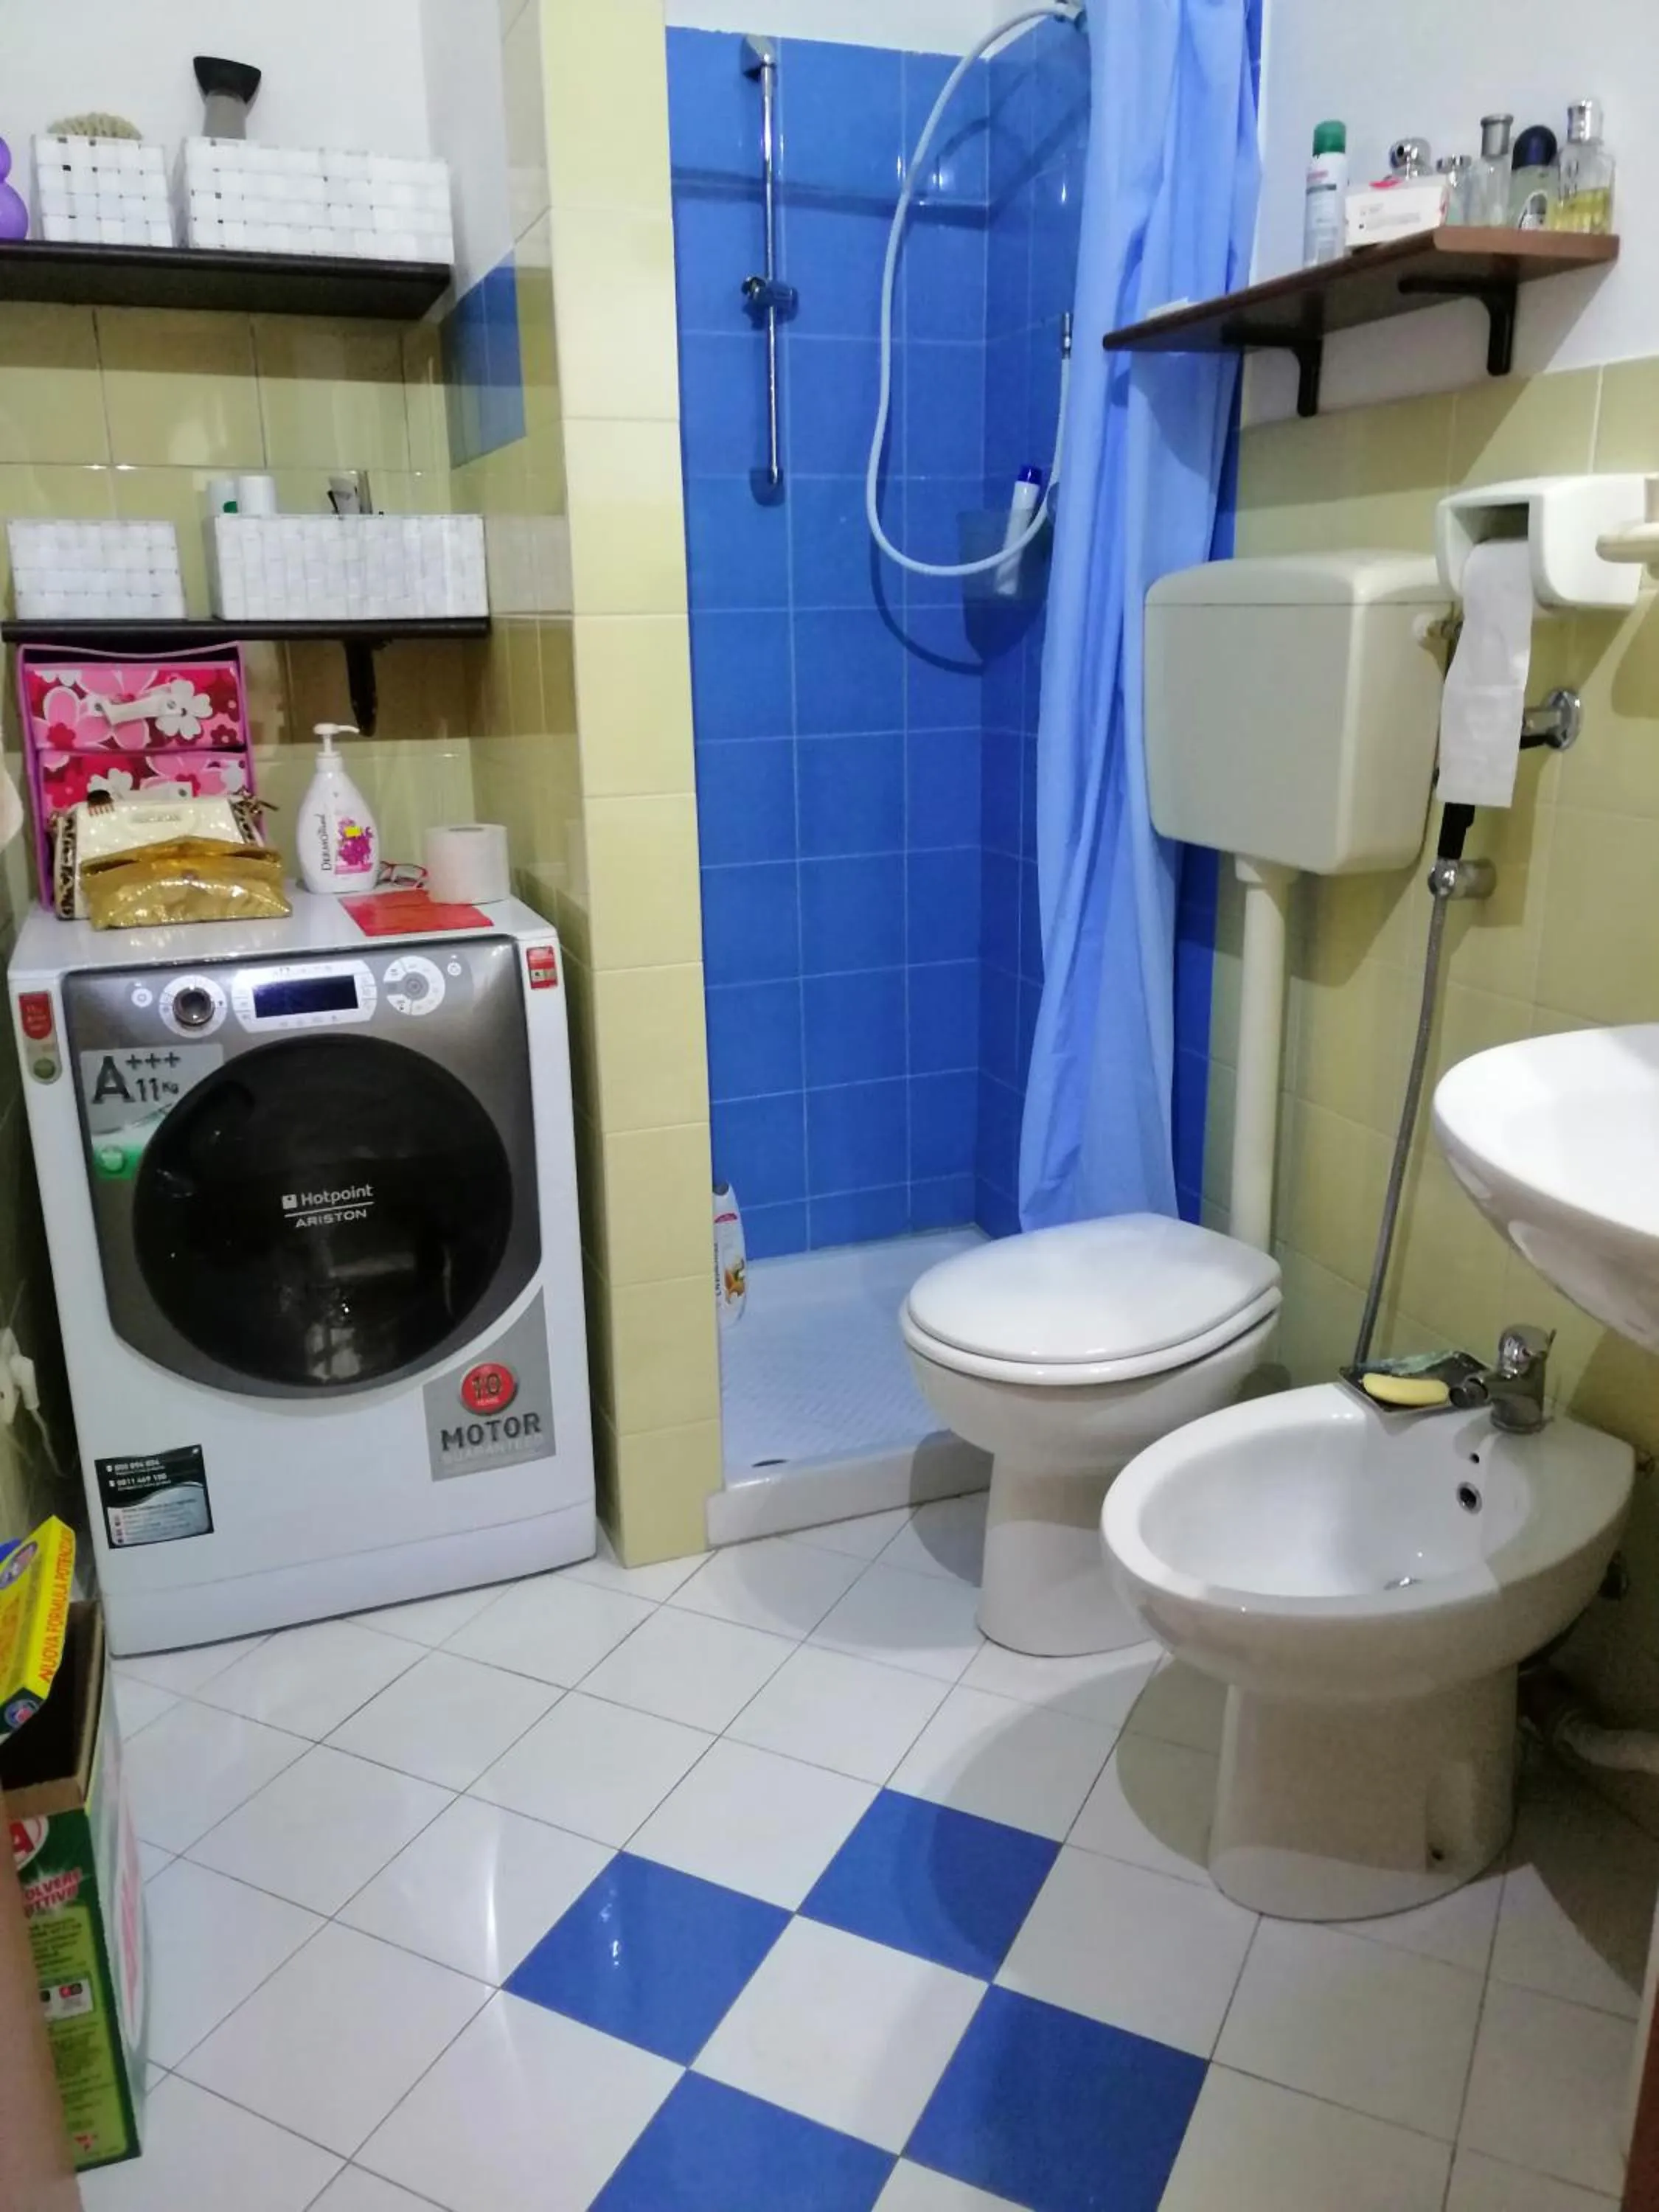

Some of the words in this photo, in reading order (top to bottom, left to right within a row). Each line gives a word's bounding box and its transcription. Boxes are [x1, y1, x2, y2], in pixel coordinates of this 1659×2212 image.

[301, 1183, 374, 1206] Hotpoint
[296, 1209, 366, 1228] ARISTON
[472, 1372, 501, 1400] 10
[440, 1412, 542, 1452] MOTOR
